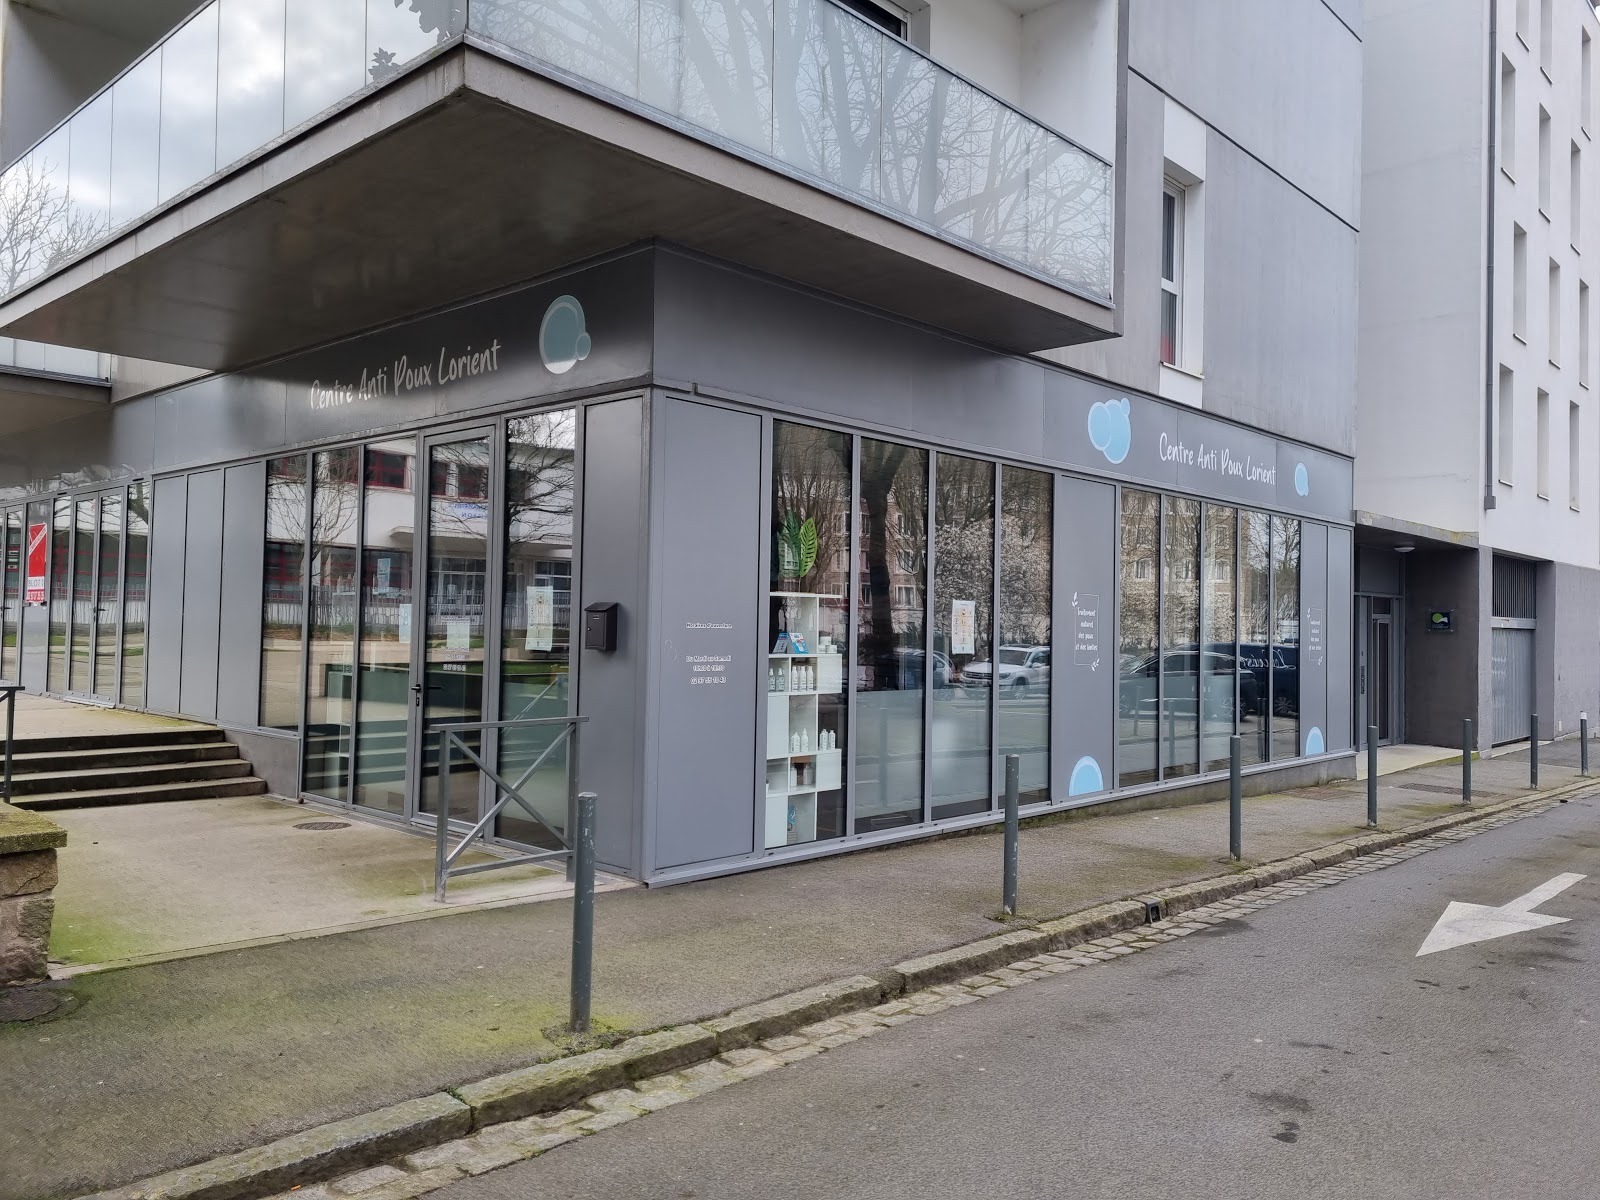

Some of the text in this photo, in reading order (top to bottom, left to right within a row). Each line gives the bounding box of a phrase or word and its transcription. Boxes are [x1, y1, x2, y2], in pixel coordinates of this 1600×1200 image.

[310, 338, 501, 411] Centre Anti Poux Lorient
[1159, 432, 1276, 486] Centre Anti Poux Lorient
